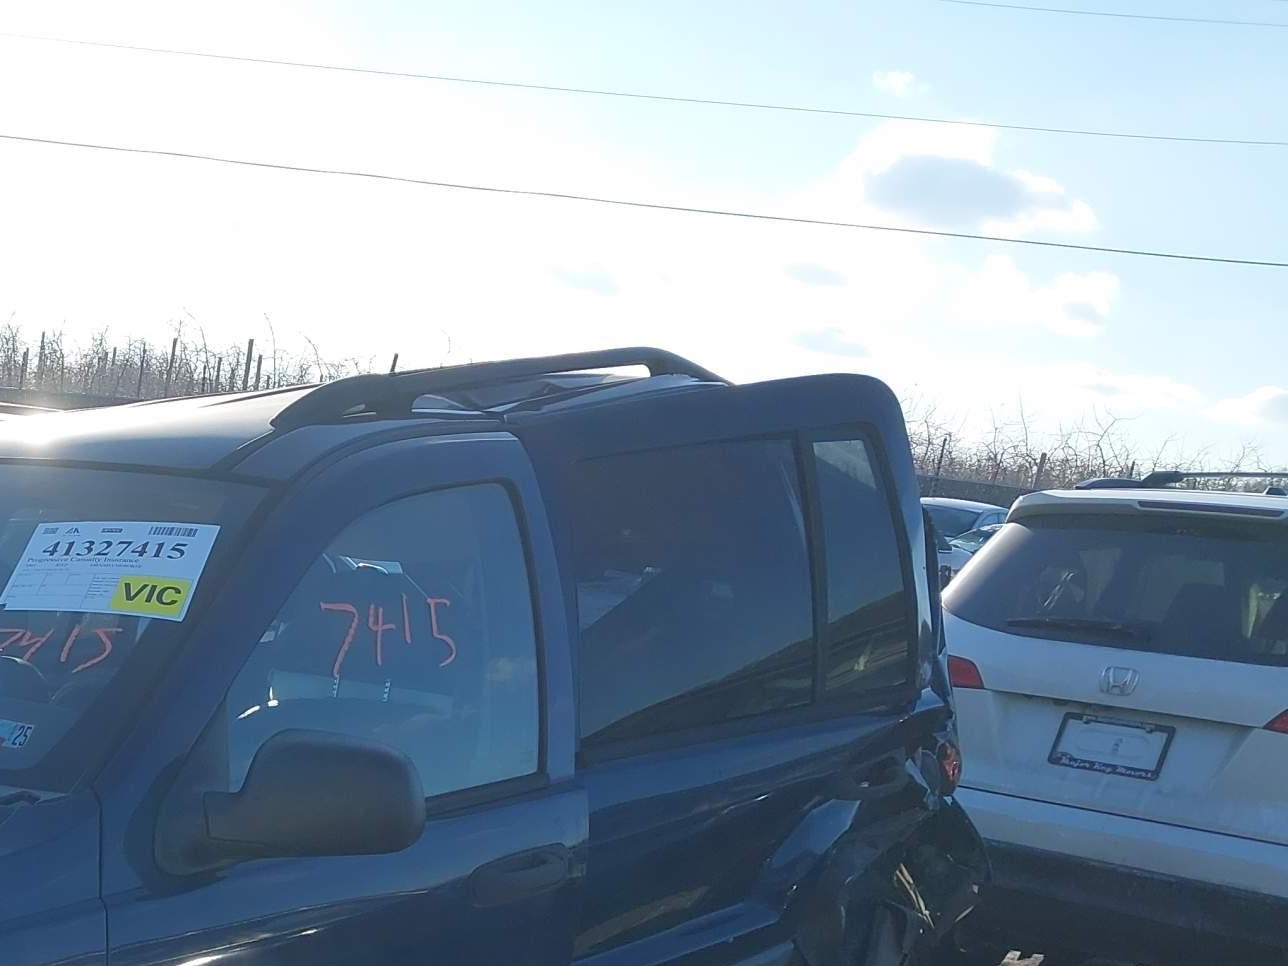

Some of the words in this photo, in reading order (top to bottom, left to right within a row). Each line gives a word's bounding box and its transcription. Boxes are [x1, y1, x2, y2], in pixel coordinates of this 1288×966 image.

[42, 540, 190, 560] 41327415
[103, 557, 141, 565] Insurance
[123, 582, 182, 606] VIC
[319, 592, 457, 678] 7415
[11, 724, 33, 747] 25
